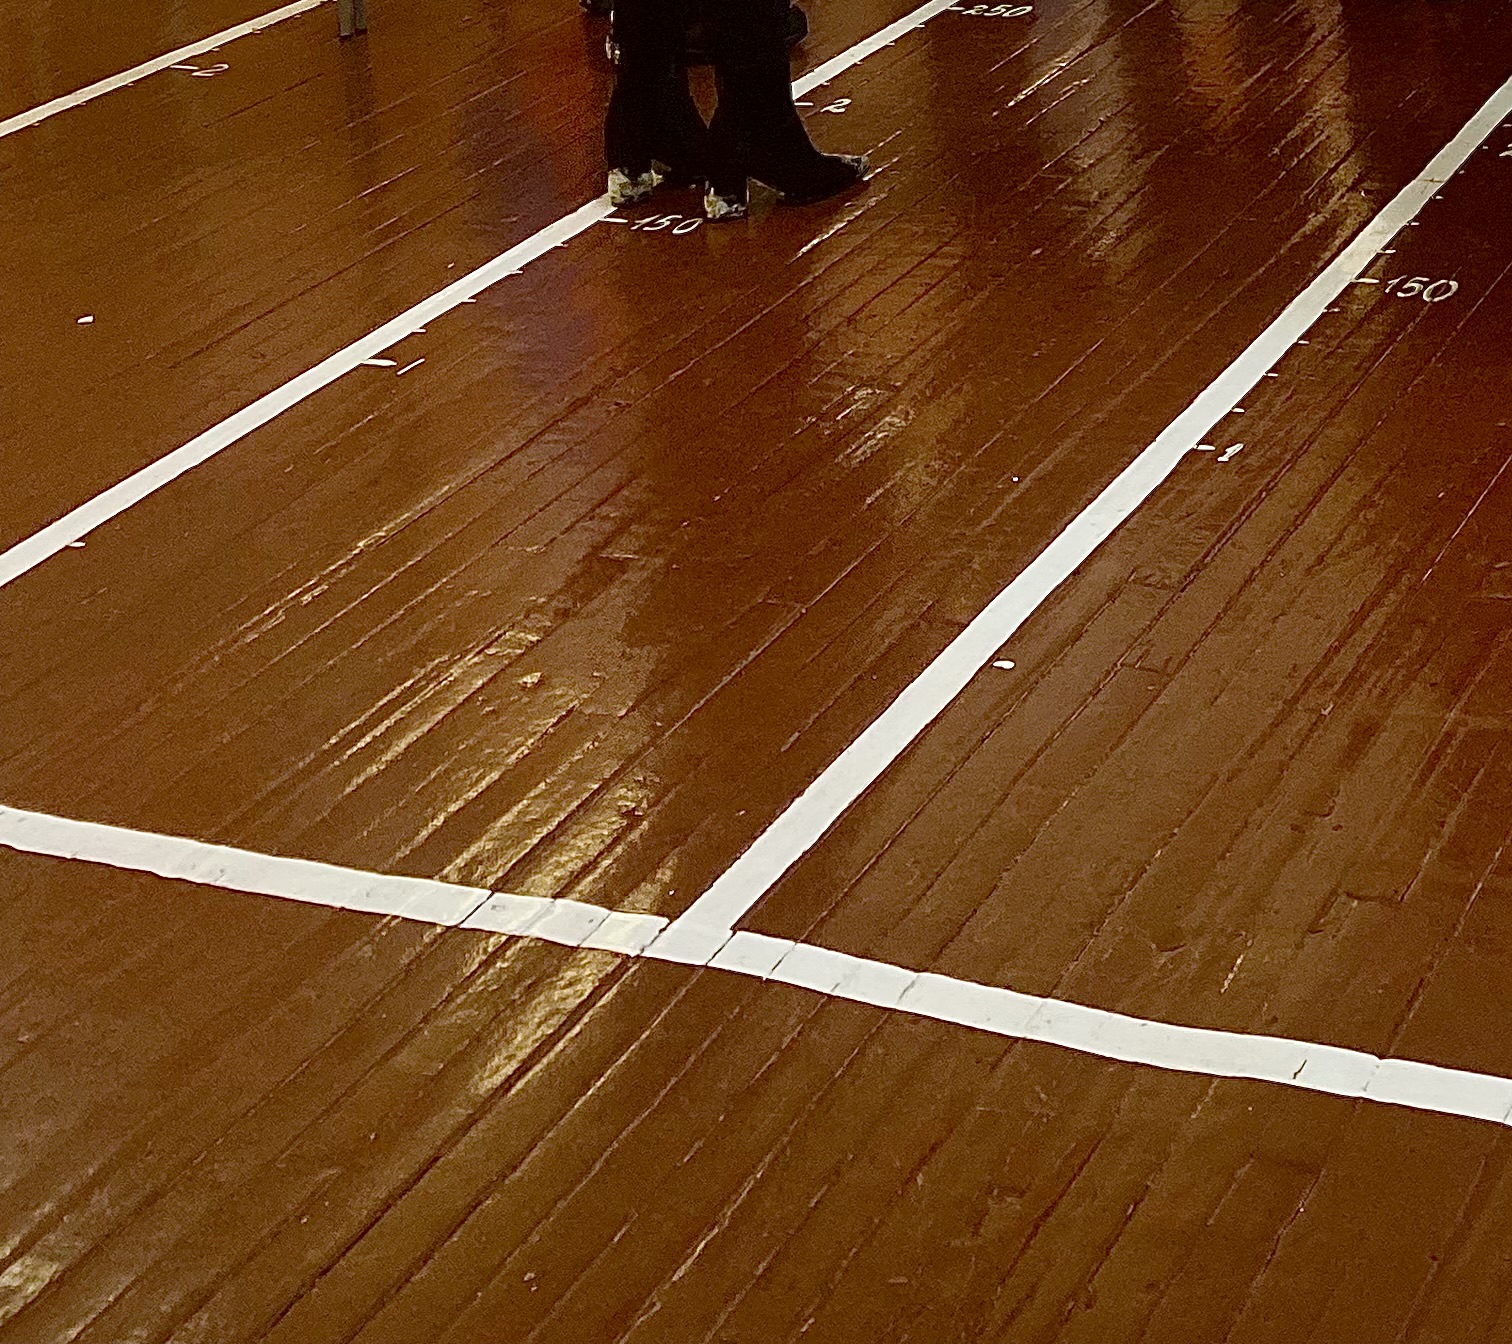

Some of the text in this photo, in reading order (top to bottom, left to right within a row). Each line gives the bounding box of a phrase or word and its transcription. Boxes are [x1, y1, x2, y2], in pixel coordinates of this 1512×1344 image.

[962, 4, 1033, 18] 250
[191, 63, 230, 77] 2
[820, 98, 852, 113] 2
[629, 214, 704, 235] 150
[1384, 274, 1460, 303] 150
